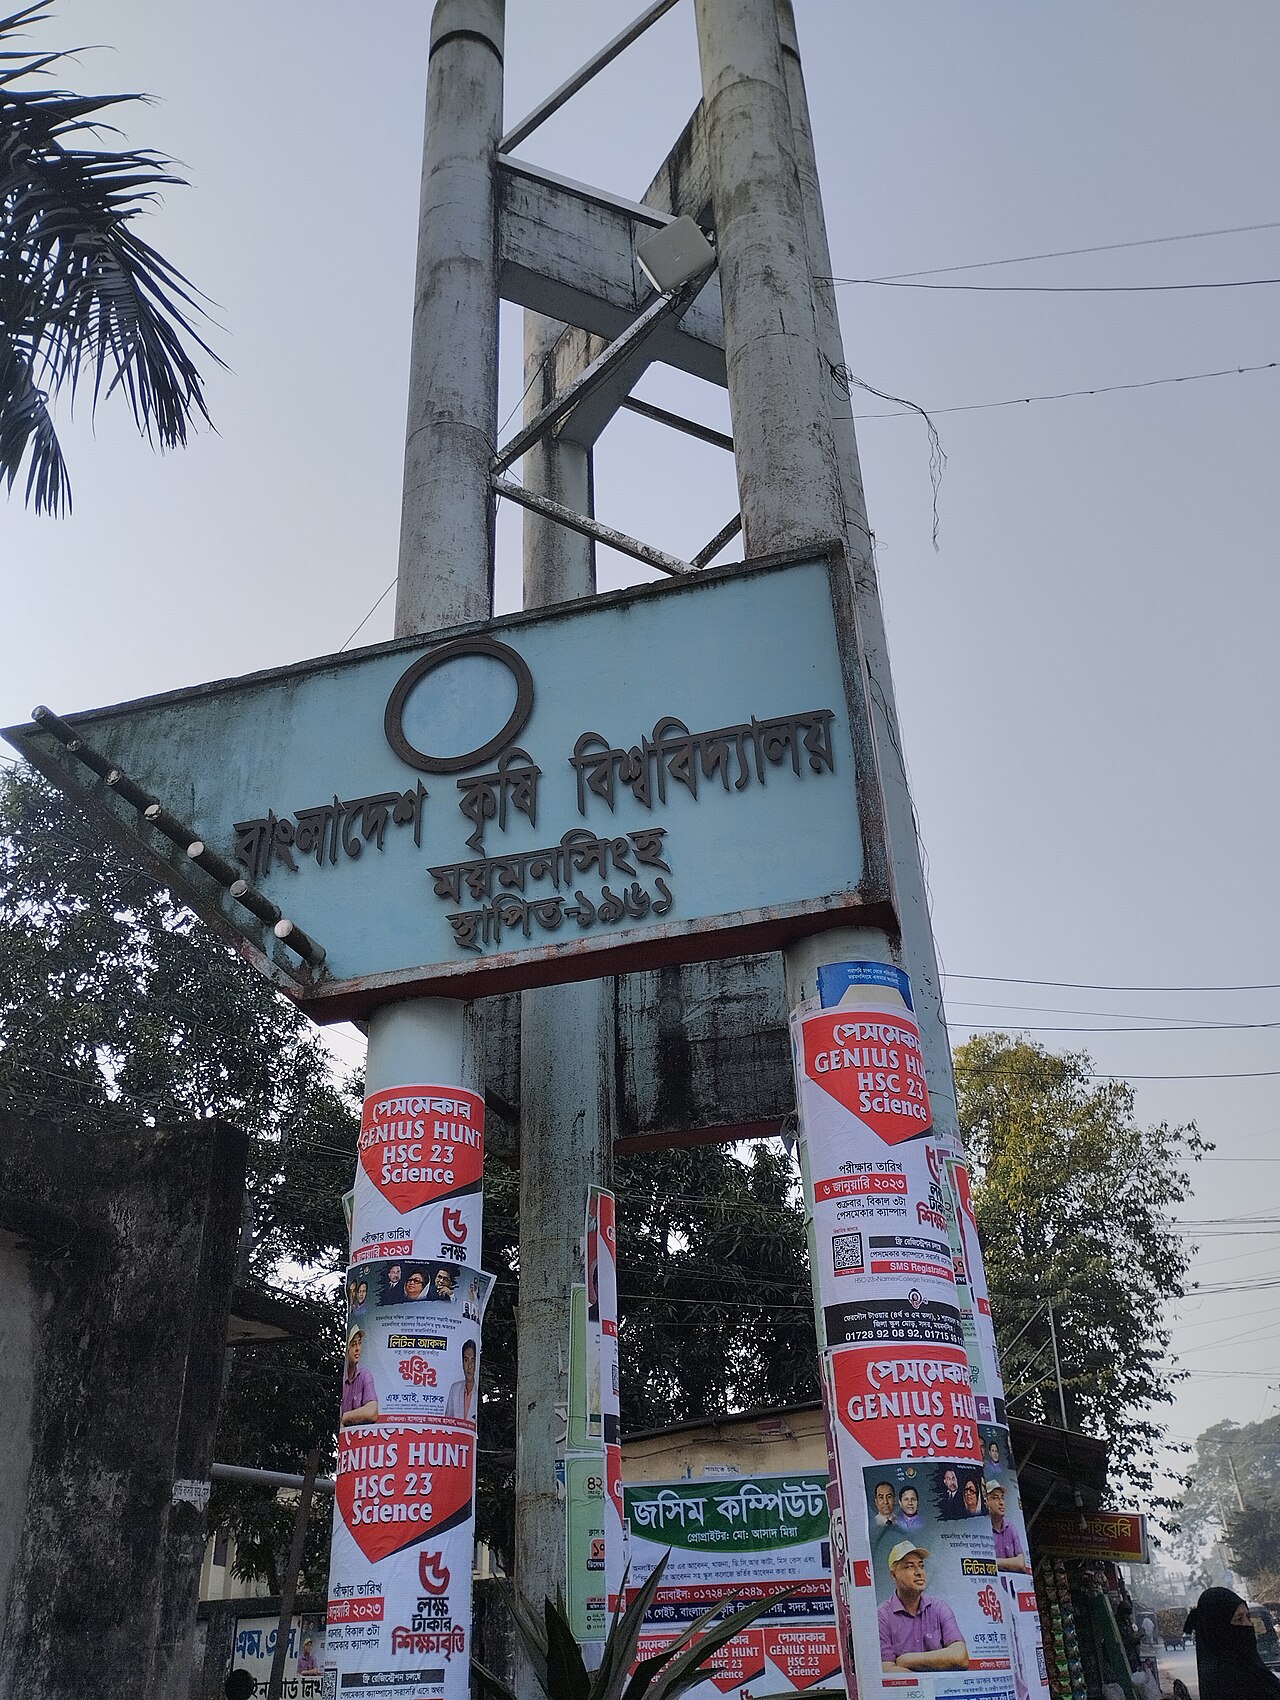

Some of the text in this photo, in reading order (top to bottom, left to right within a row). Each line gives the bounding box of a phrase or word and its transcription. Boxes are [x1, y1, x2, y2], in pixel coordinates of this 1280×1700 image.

[234, 709, 835, 878] বাংলাদেশ কৃষি বিশ্ববিদ্যালয়
[427, 828, 672, 903] ময়মনসিংহ
[815, 1047, 926, 1081] GENIUS HU
[857, 1072, 924, 1100] HSC 23
[373, 1096, 471, 1123] পেসমেকার
[859, 1091, 927, 1122] Science
[361, 1120, 481, 1150] GENIUS HUNT
[382, 1144, 454, 1165] HSC 23
[381, 1162, 454, 1185] Science
[839, 1159, 902, 1174] পরীক্ষার তারিখ
[823, 1176, 904, 1195] ৬ জানুয়ারি ২০২৩
[867, 1195, 889, 1206] বিকাল
[893, 1195, 906, 1206] ৩টা
[837, 1208, 907, 1220] পেসমেকার ক্যাম্পাস
[442, 1207, 467, 1244] ৫
[383, 1244, 410, 1257] ২০২৩
[890, 1262, 949, 1277] SMS Registration
[389, 1334, 415, 1348] লিটন
[845, 1330, 874, 1341] 01728
[876, 1329, 889, 1339] 92
[892, 1329, 905, 1338] 08
[907, 1329, 923, 1339] 92,
[925, 1330, 949, 1341] 01715
[398, 1355, 428, 1380] মুক্তি
[848, 1391, 945, 1421] GENIUS
[897, 1423, 973, 1449] HSC 23
[408, 1442, 470, 1468] HUNT
[354, 1472, 433, 1500] HSC 23
[352, 1498, 433, 1526] Science
[631, 1481, 826, 1529] জসিম কম্পিউট
[751, 1528, 778, 1539] আসাদ
[779, 1525, 798, 1538] মিয়া
[418, 1551, 451, 1596] ৫
[963, 1558, 985, 1575] লিটন
[357, 1580, 382, 1595] তারিখ
[353, 1602, 381, 1618] ২০২৩
[417, 1597, 449, 1617] লক্ষ
[680, 1607, 713, 1618] বাংলাদে
[788, 1602, 810, 1613] সদর,
[345, 1624, 380, 1637] বিকাল ৩টা
[412, 1613, 452, 1632] টাকার
[351, 1638, 379, 1650] ক্যাম্পাস
[391, 1625, 465, 1662] শিক্ষাবৃত্তি
[778, 1632, 826, 1645] পেসমেকার
[732, 1646, 759, 1657] HUNT
[769, 1644, 836, 1655] GENIUS HUNT
[711, 1659, 743, 1669] HSC 23
[787, 1656, 820, 1667] HSC 23
[712, 1669, 744, 1680] Science
[787, 1666, 821, 1677] Science
